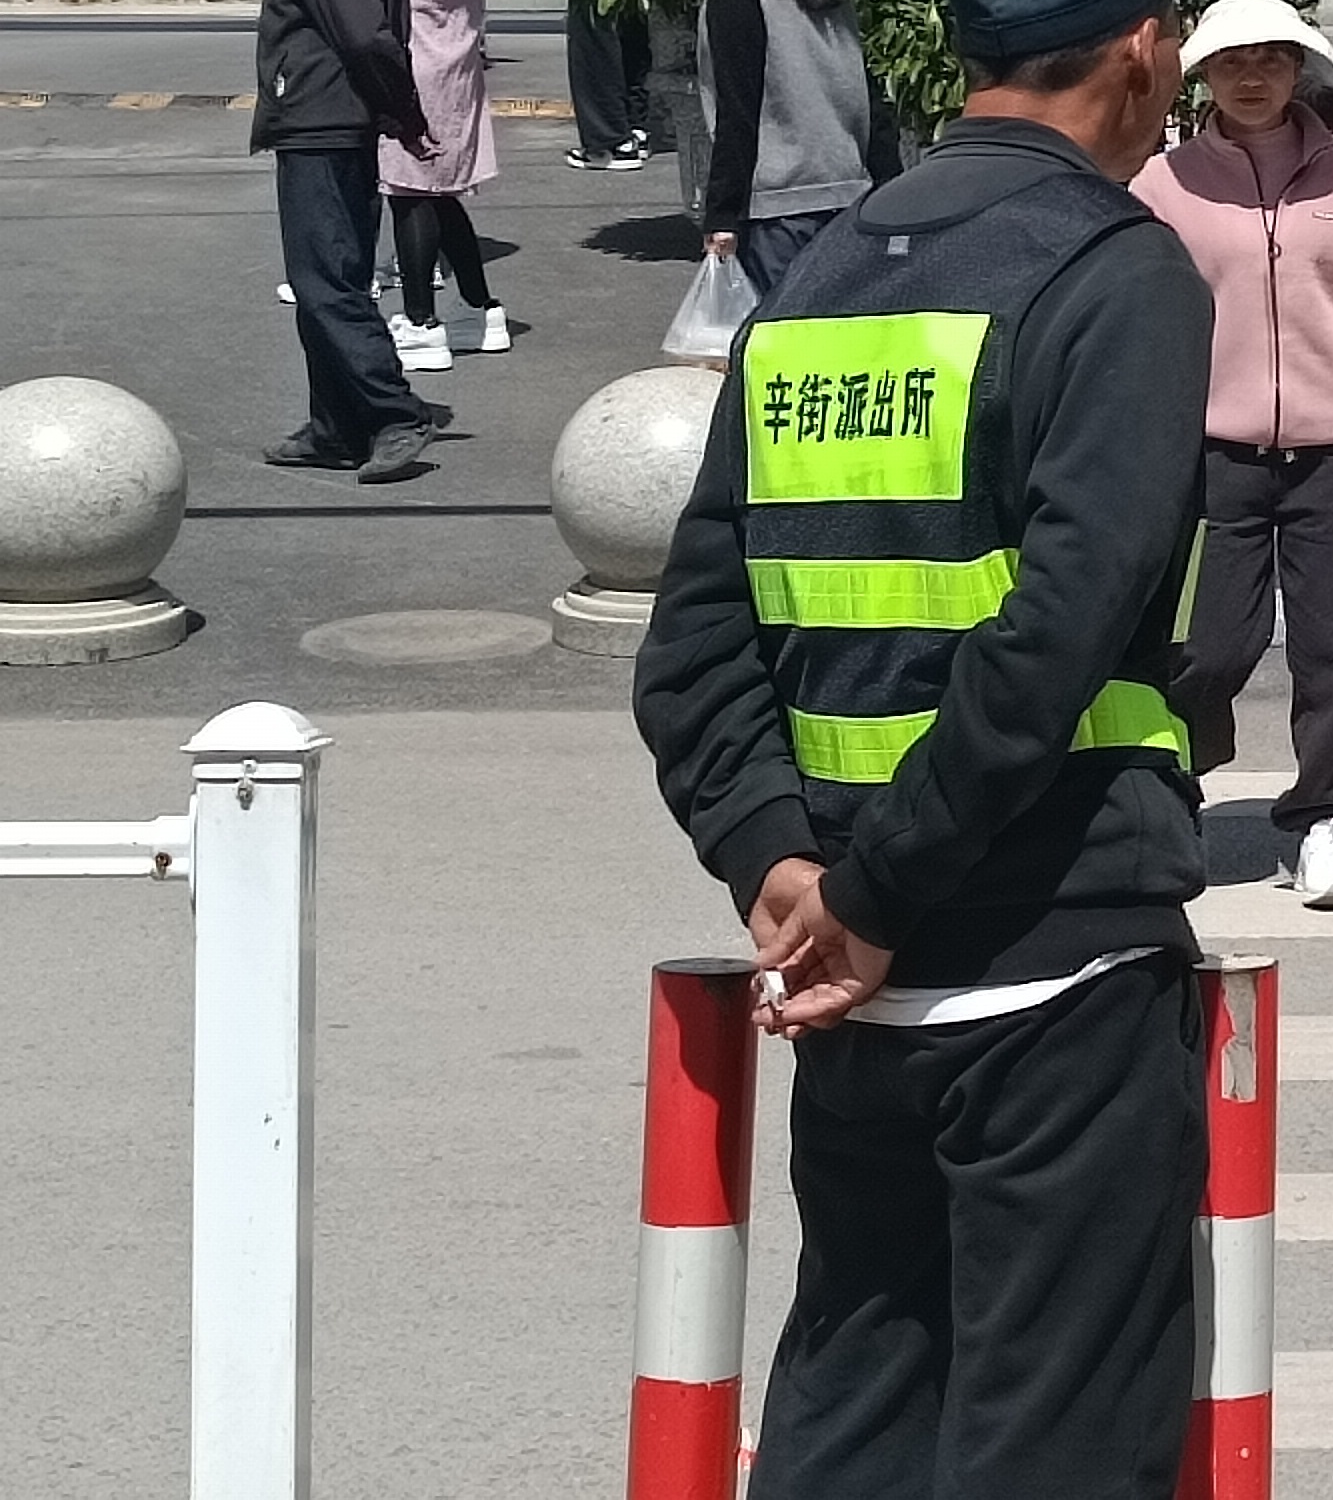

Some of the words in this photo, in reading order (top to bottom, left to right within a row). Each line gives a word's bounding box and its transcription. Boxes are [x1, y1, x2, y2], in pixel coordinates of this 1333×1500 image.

[763, 367, 936, 445] 辛街派出所
